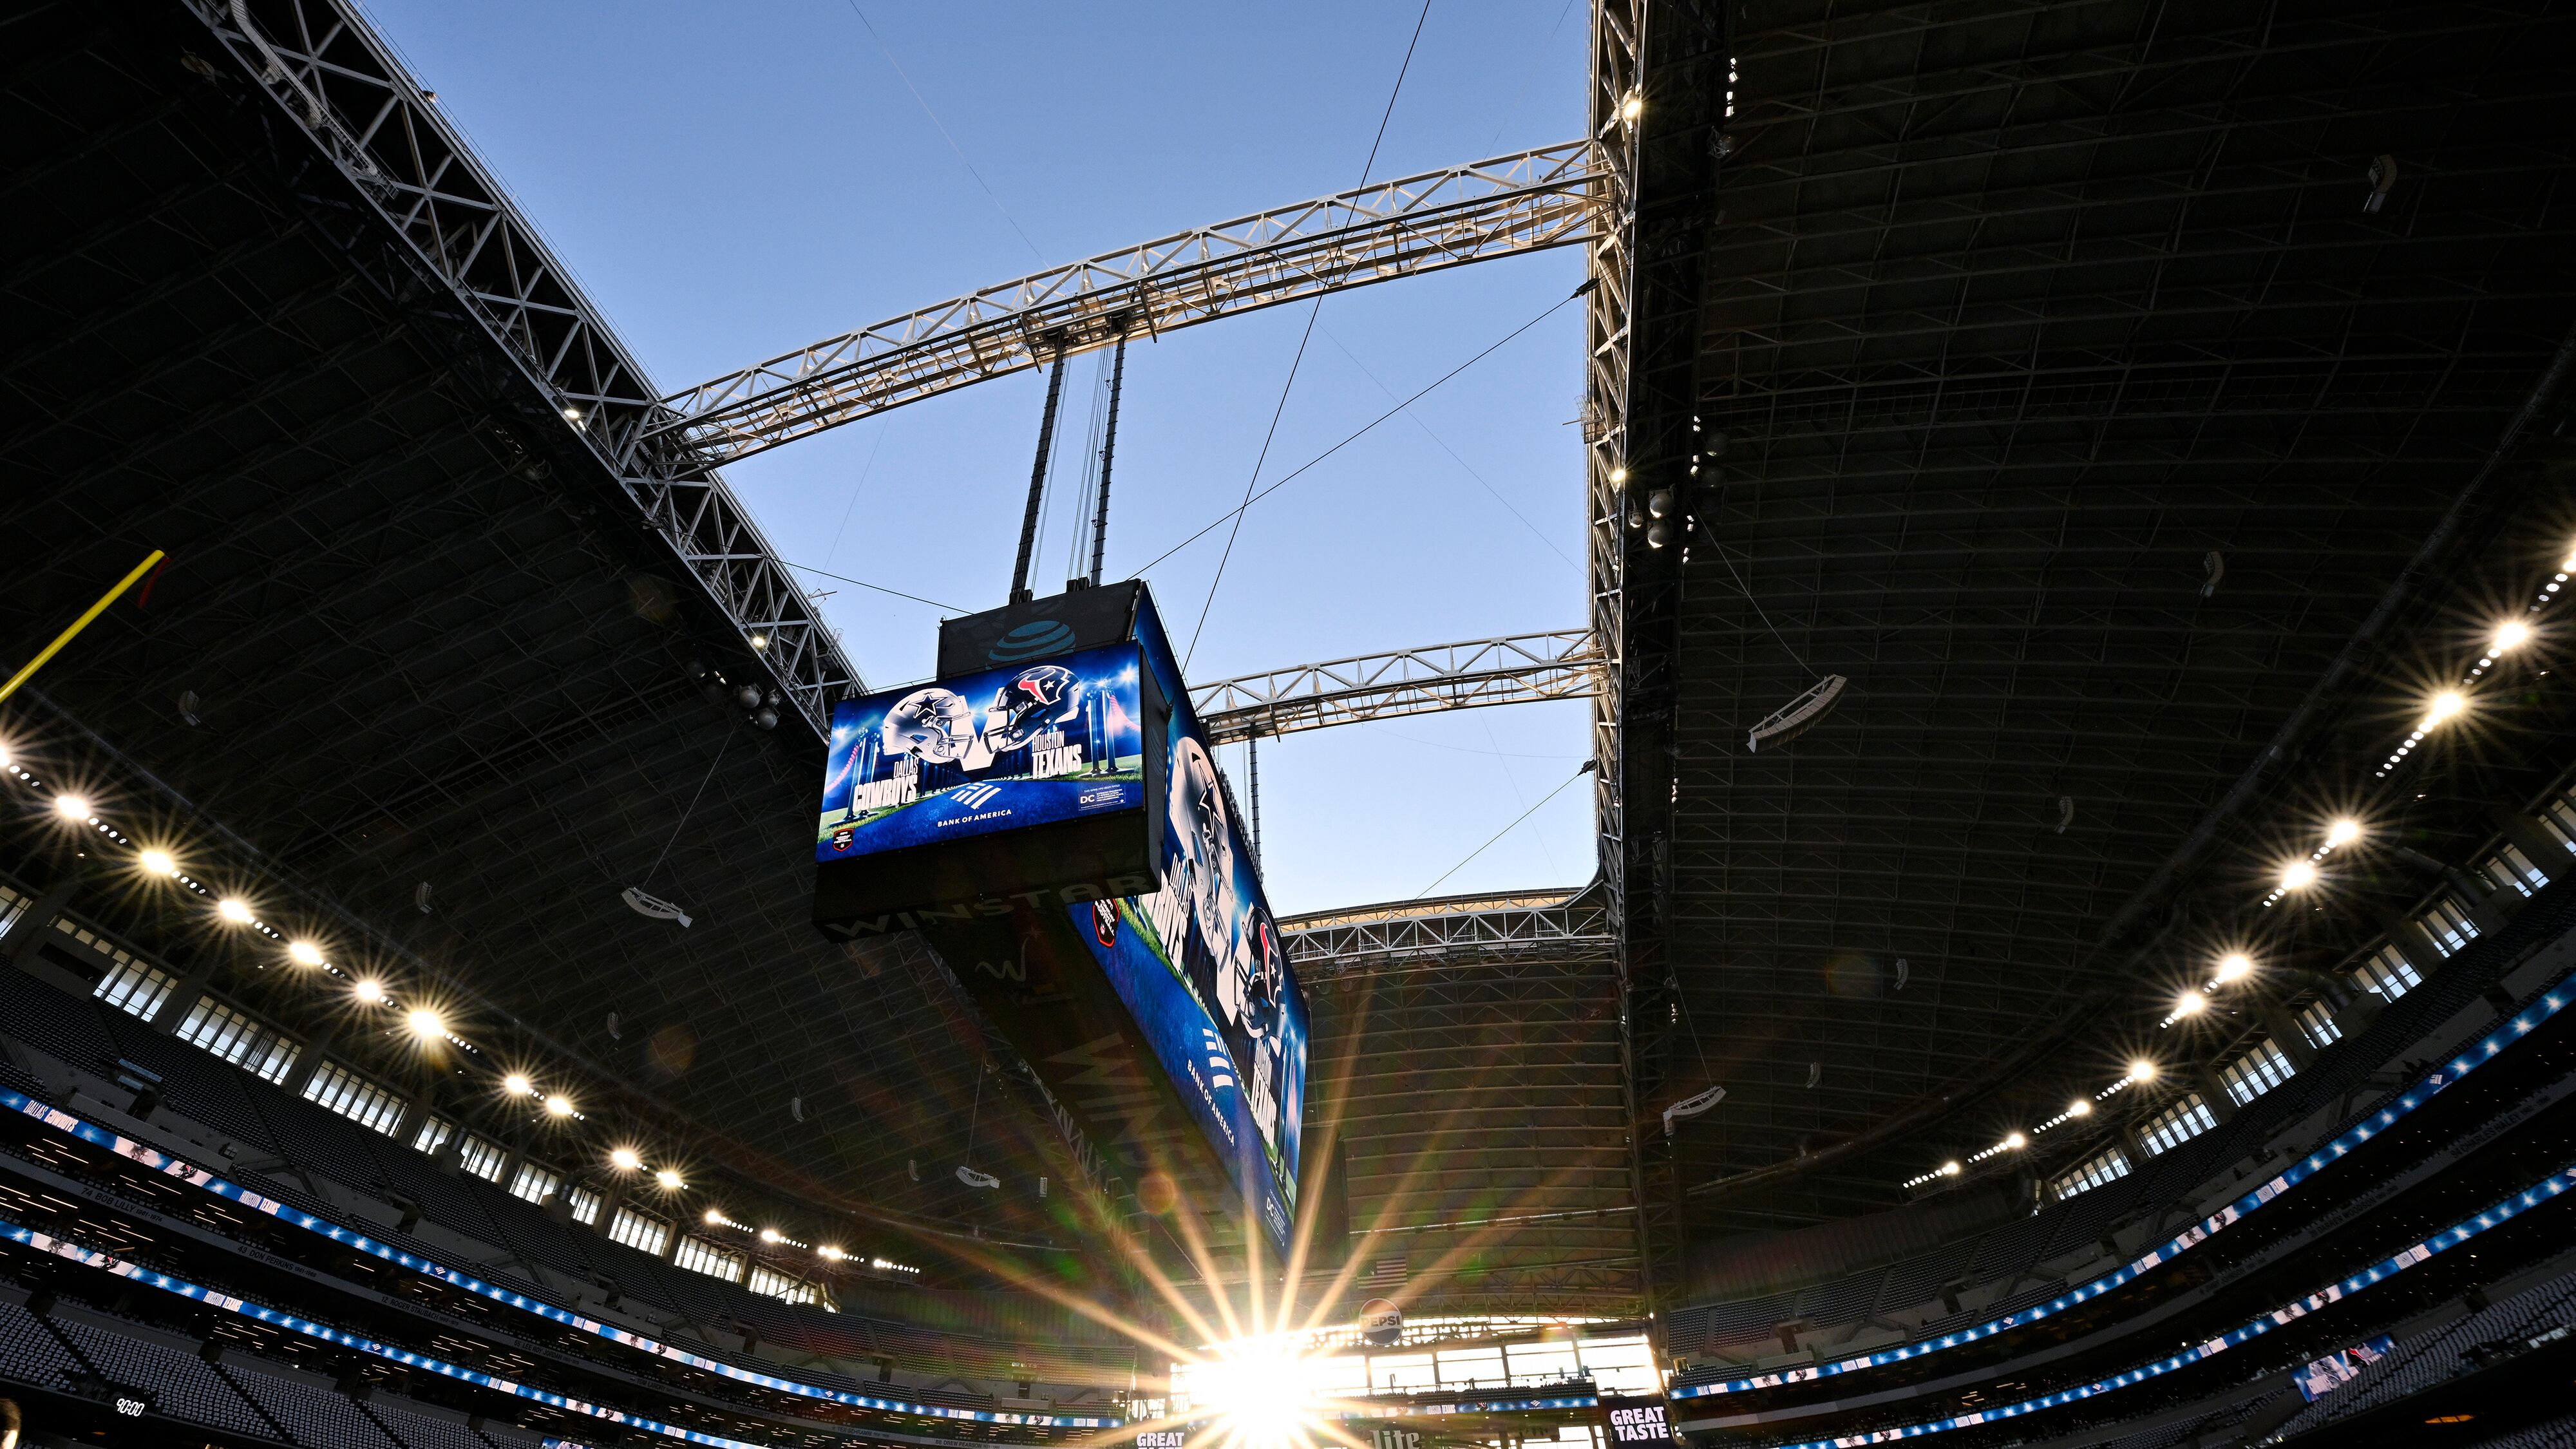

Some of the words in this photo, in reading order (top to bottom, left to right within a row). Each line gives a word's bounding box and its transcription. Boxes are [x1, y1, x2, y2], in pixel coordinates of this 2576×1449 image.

[1032, 730, 1064, 752] HOUSTON
[893, 757, 919, 778] DALLAS
[1032, 744, 1081, 779] TEXANS
[853, 774, 918, 812] COWBOYS
[1080, 794, 1095, 804] DC
[938, 818, 960, 827] BANK
[974, 809, 1012, 821] AMERICA
[825, 876, 1151, 939] WINSTAR
[23, 1100, 49, 1119] DALLAS
[1188, 1059, 1204, 1093] BANK
[1204, 1090, 1213, 1105] OF
[1211, 1103, 1235, 1146] AMERICA
[81, 1188, 93, 1197] 74
[95, 1193, 113, 1205] BOB
[115, 1197, 135, 1212] LILLY
[249, 1249, 264, 1260] DON
[266, 1256, 294, 1270] PERKINS
[390, 1298, 410, 1311] ROGER
[410, 1305, 439, 1320] STAUBACH
[1361, 1315, 1401, 1327] PEPSI
[117, 1398, 145, 1417] 90:00
[1611, 1406, 1664, 1425] GREAT
[1137, 1432, 1184, 1447] GREAT
[1370, 1430, 1420, 1449] lite
[1615, 1423, 1669, 1441] TASTE
